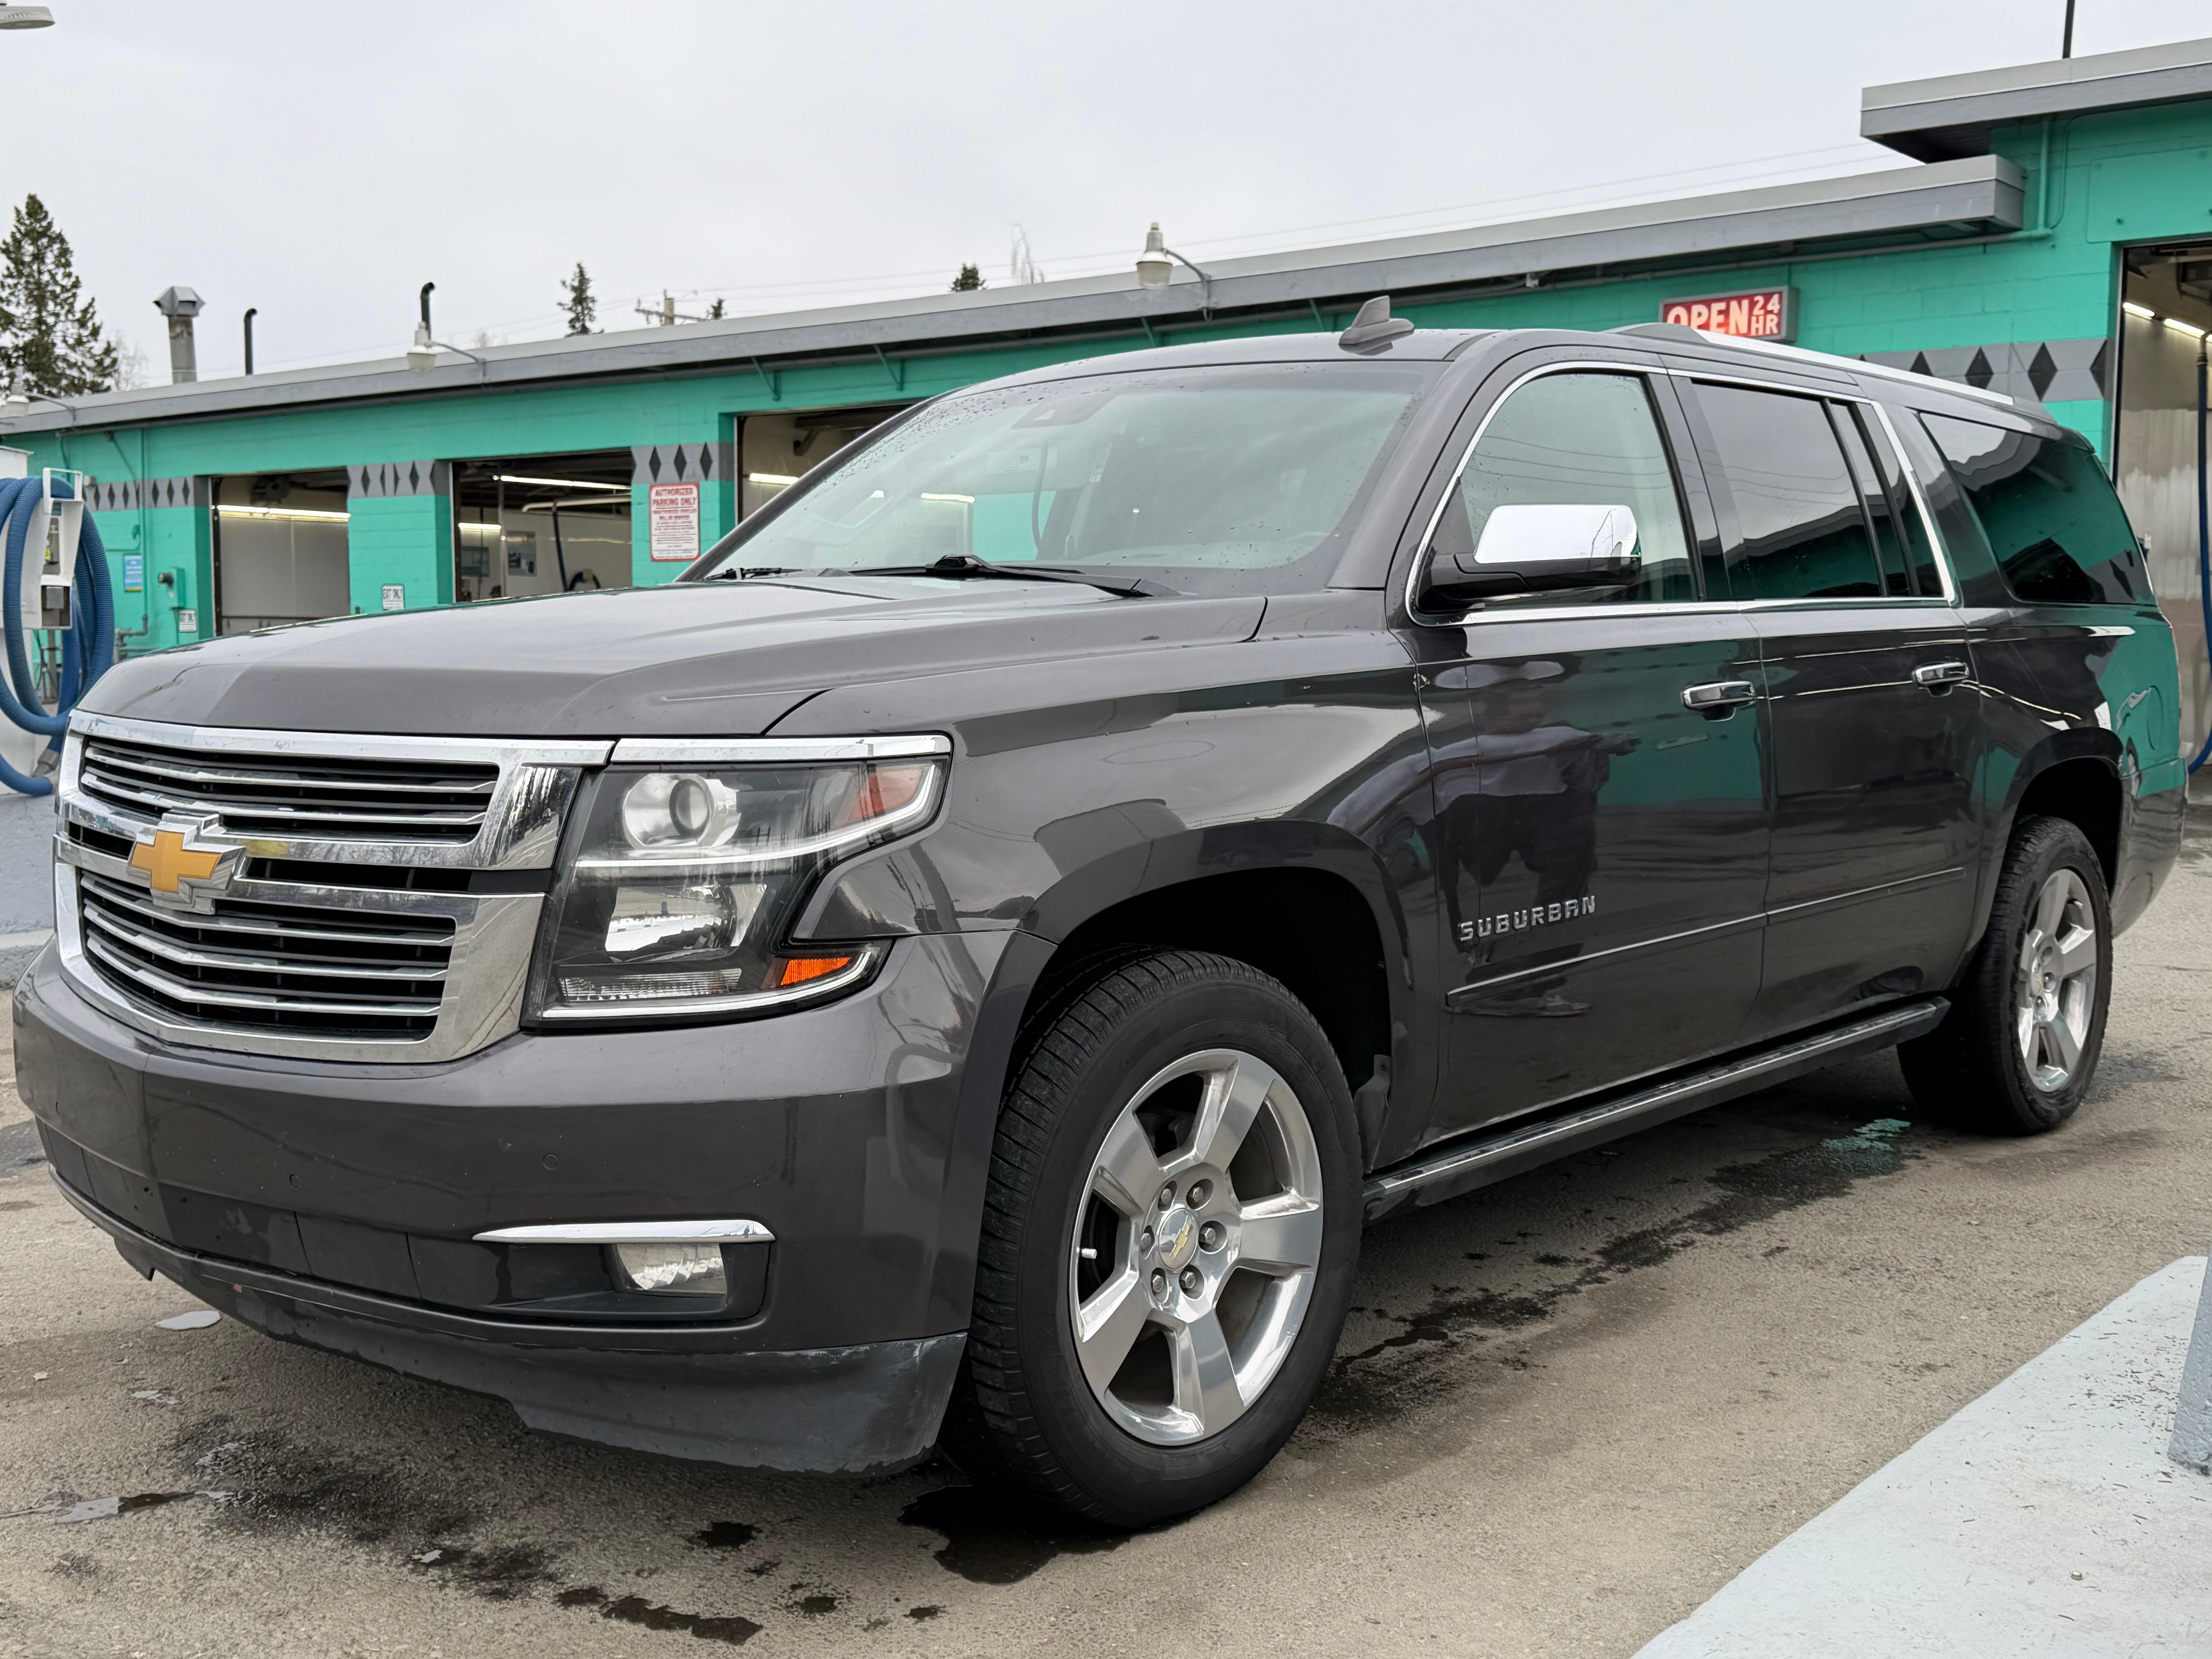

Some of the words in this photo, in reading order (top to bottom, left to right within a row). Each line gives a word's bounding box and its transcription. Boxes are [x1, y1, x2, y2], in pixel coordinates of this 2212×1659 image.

[1753, 294, 1781, 316] 24
[1667, 299, 1749, 334] OPEN
[1751, 314, 1779, 336] HR
[653, 498, 678, 507] PARKING
[1458, 895, 1595, 941] SUBURBAN
